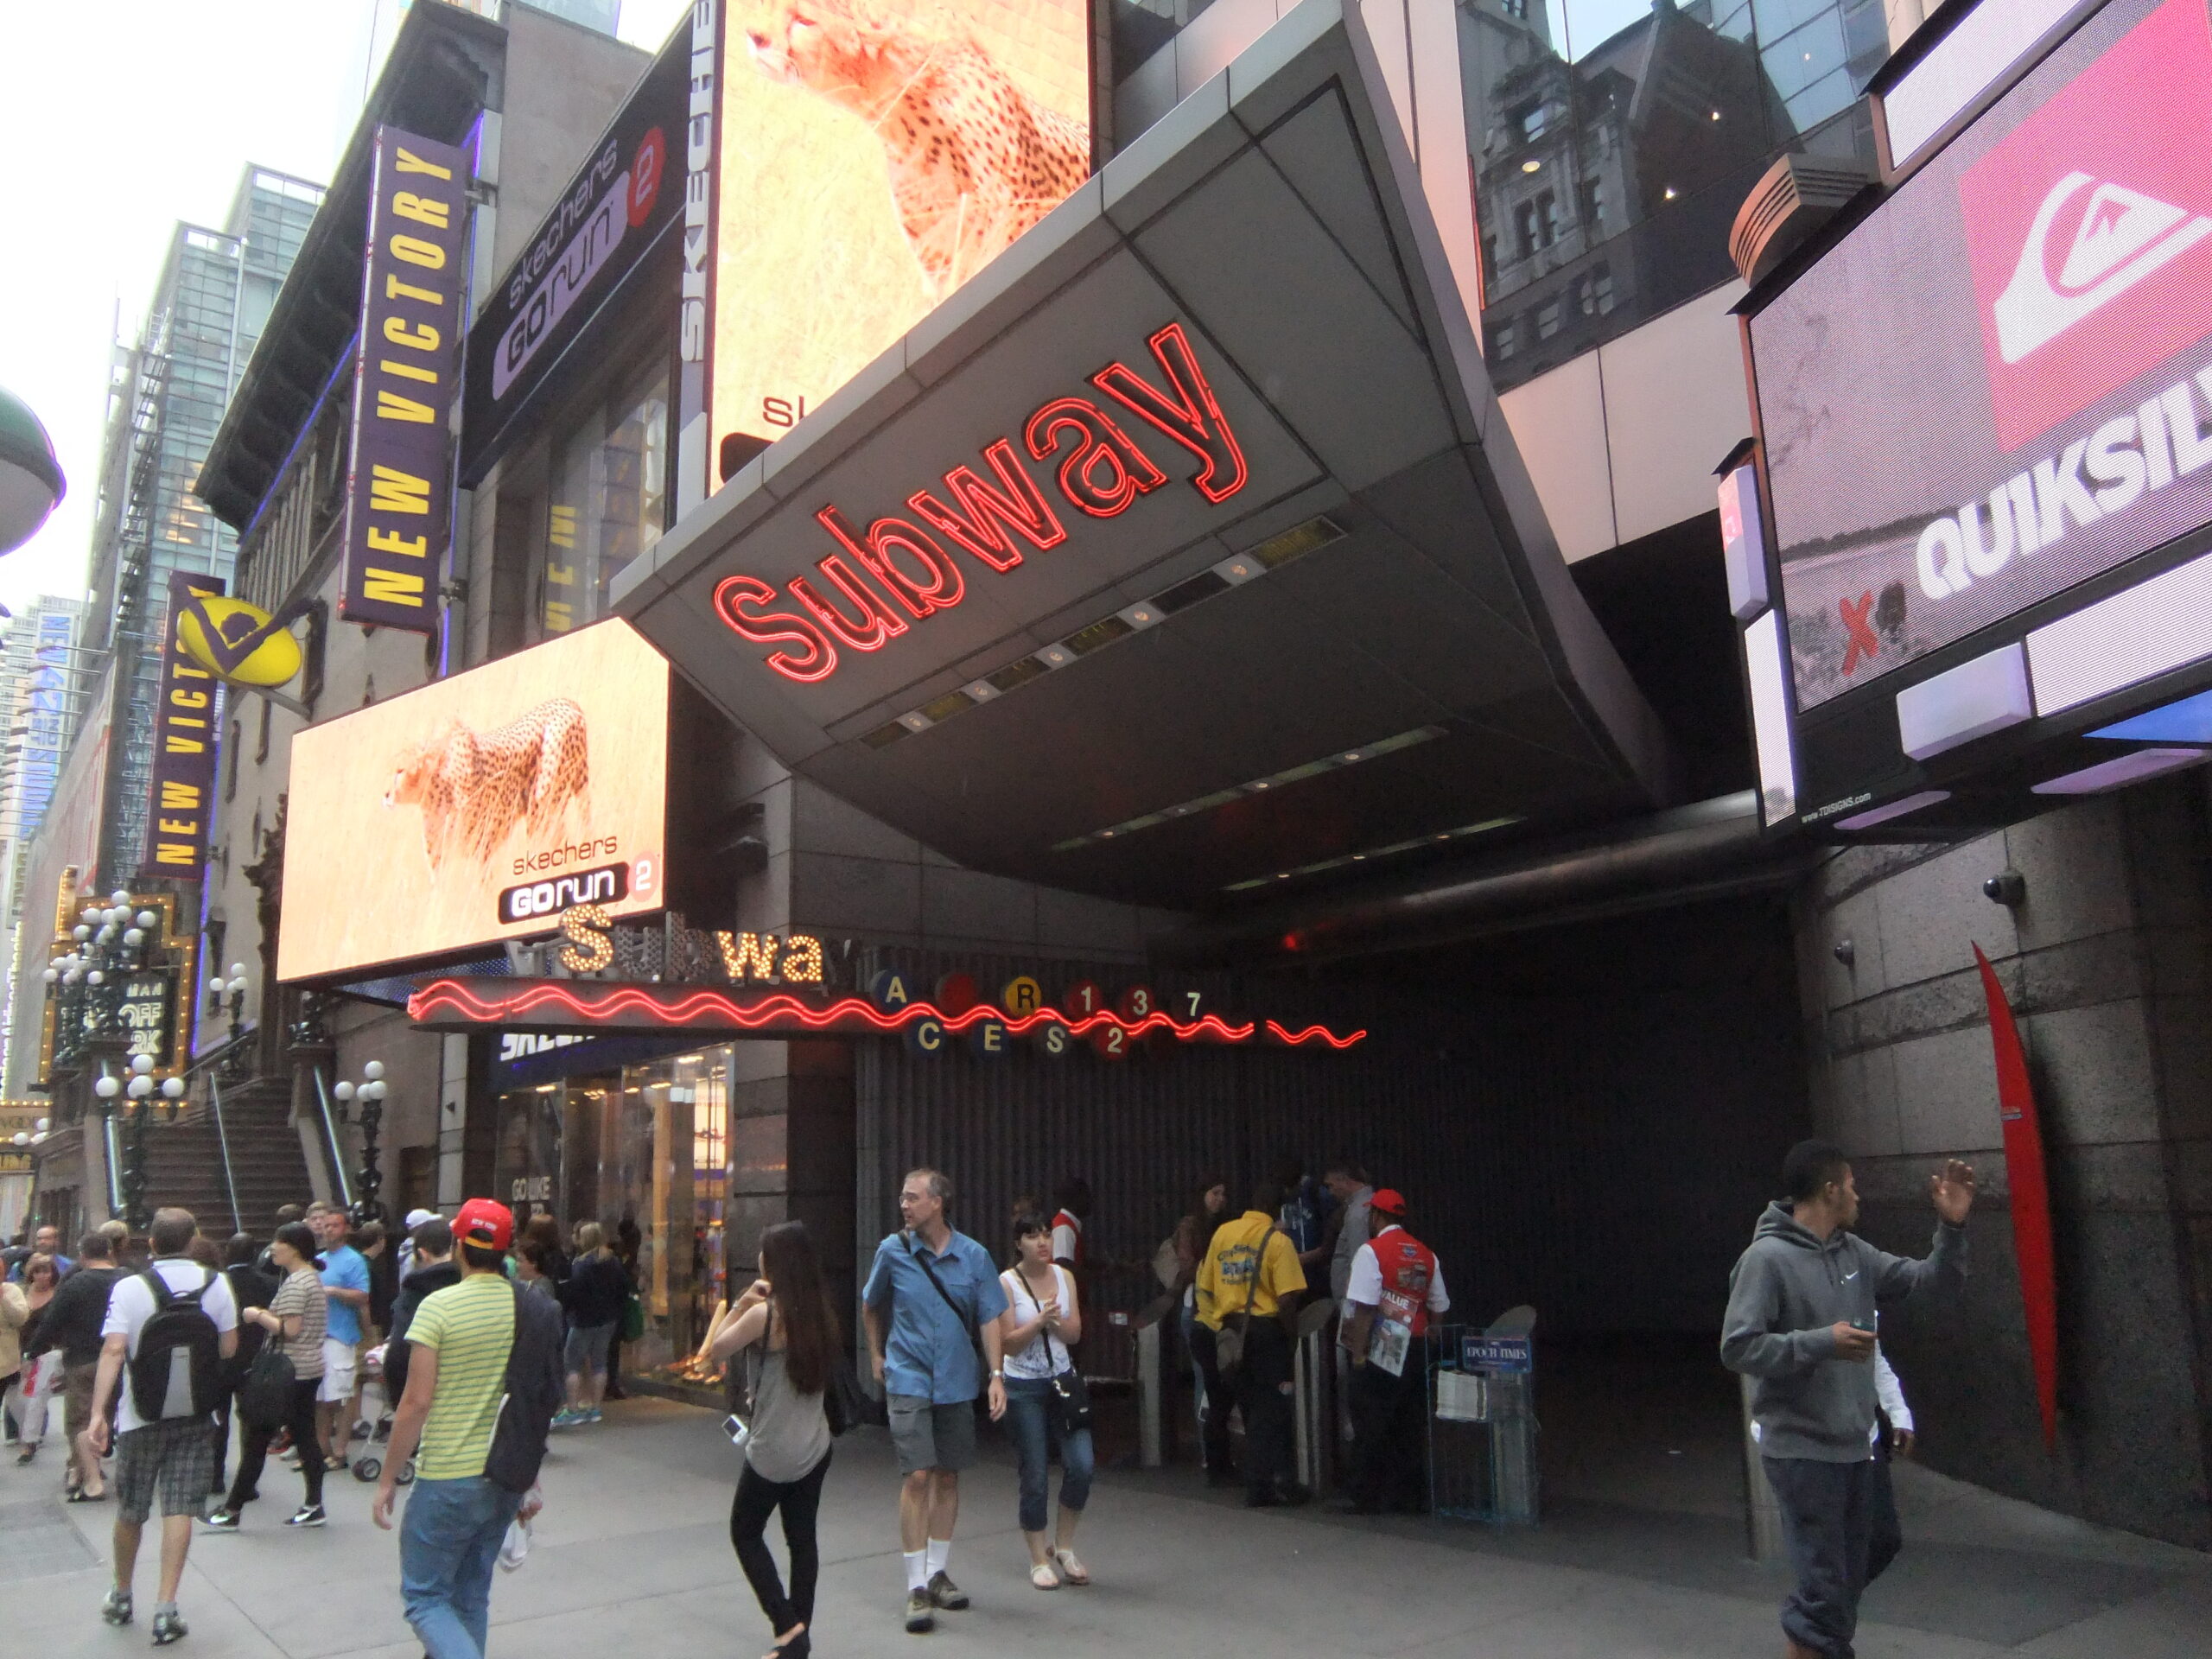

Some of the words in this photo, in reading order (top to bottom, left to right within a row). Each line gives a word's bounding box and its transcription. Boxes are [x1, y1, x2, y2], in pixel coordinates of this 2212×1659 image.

[635, 144, 654, 207] 2
[509, 137, 618, 309] skechers
[377, 147, 451, 423] VICTORY
[712, 321, 1249, 685] Subway
[364, 464, 430, 607] NEW
[156, 781, 201, 865] NEW
[512, 836, 617, 876] skechers
[635, 860, 652, 892] 2
[886, 976, 907, 1003] A
[1017, 983, 1035, 1009] R
[1081, 986, 1091, 1012] 1
[1133, 989, 1148, 1015] 3
[1187, 992, 1201, 1017] 7
[918, 1021, 940, 1050] C
[984, 1024, 1002, 1051] E
[1046, 1026, 1065, 1053] S
[1107, 1027, 1122, 1053] 2
[1499, 1348, 1528, 1360] TIMES
